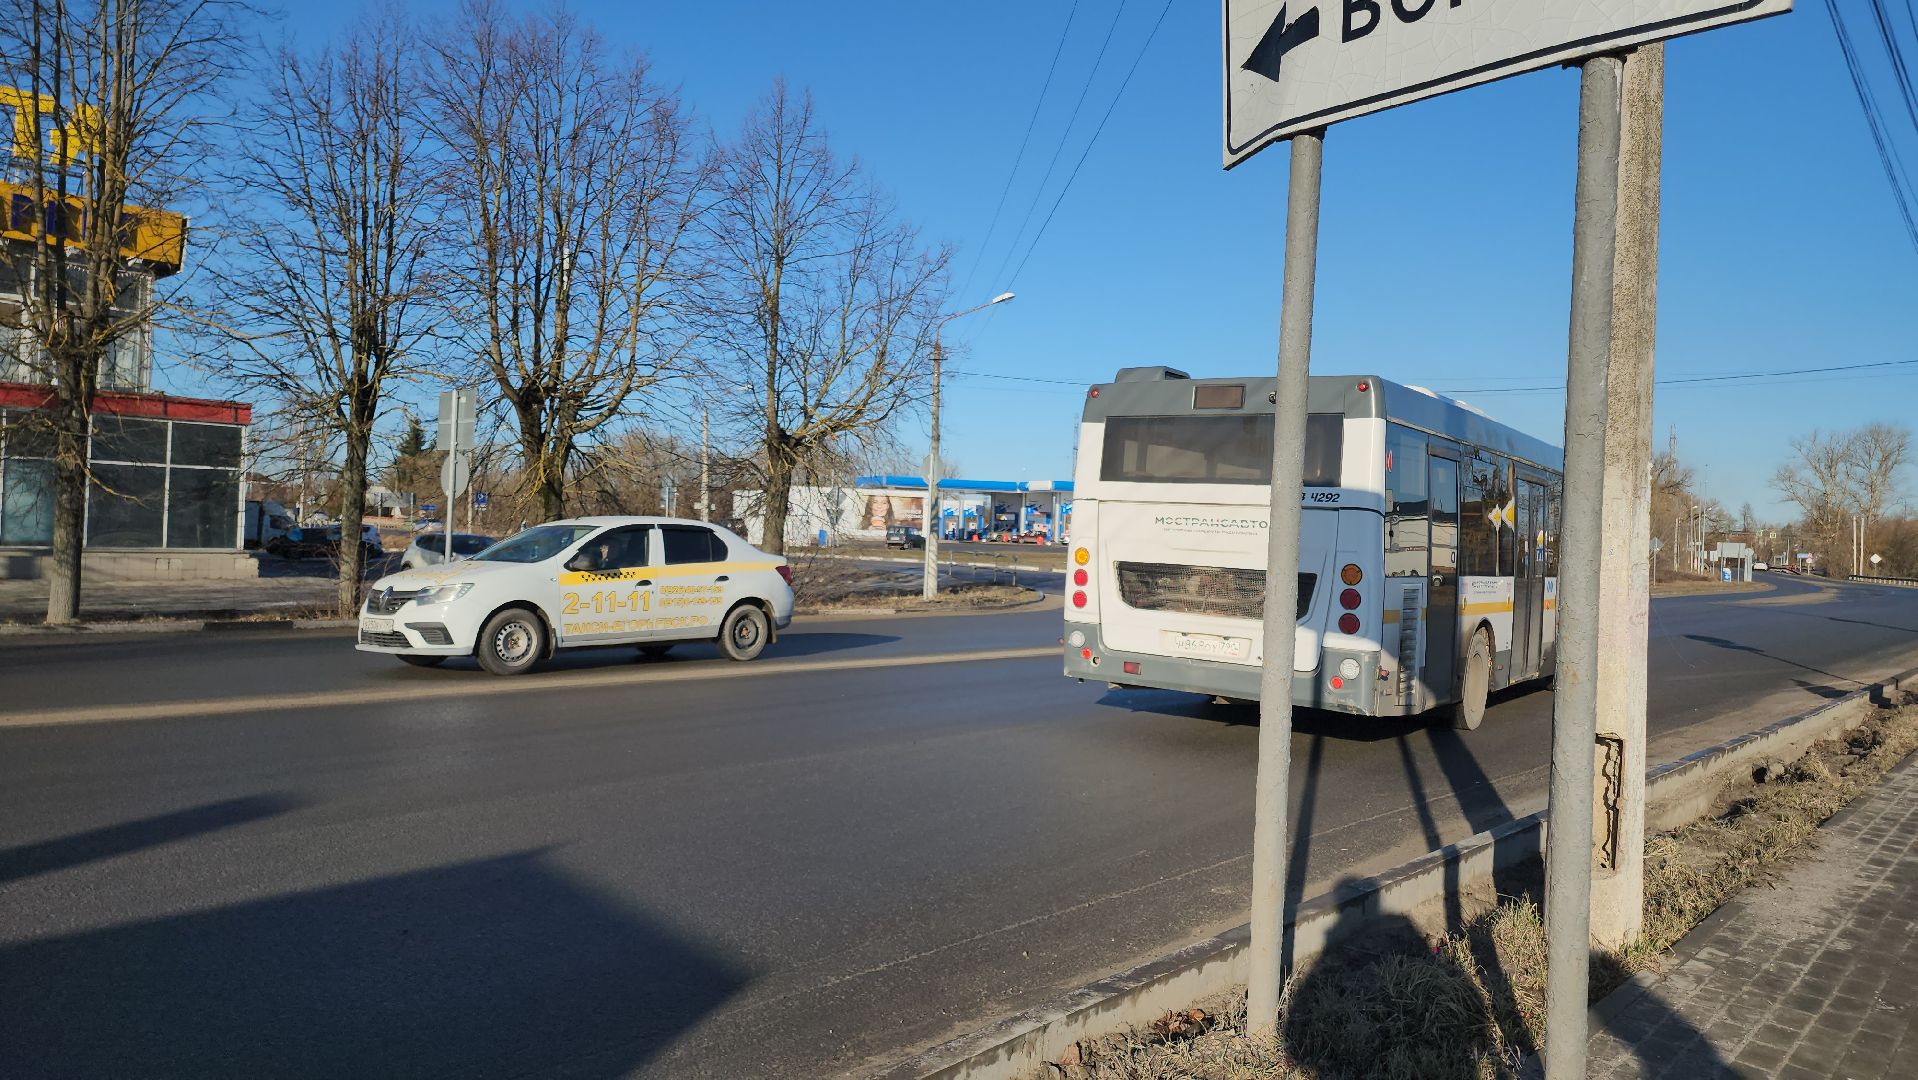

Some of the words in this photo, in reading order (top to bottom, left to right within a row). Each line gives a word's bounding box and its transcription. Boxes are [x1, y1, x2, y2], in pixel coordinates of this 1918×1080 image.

[1310, 492, 1341, 503] 4292
[1154, 516, 1269, 530] МОСТРАНСАВТО
[562, 590, 651, 615] 2-11-11
